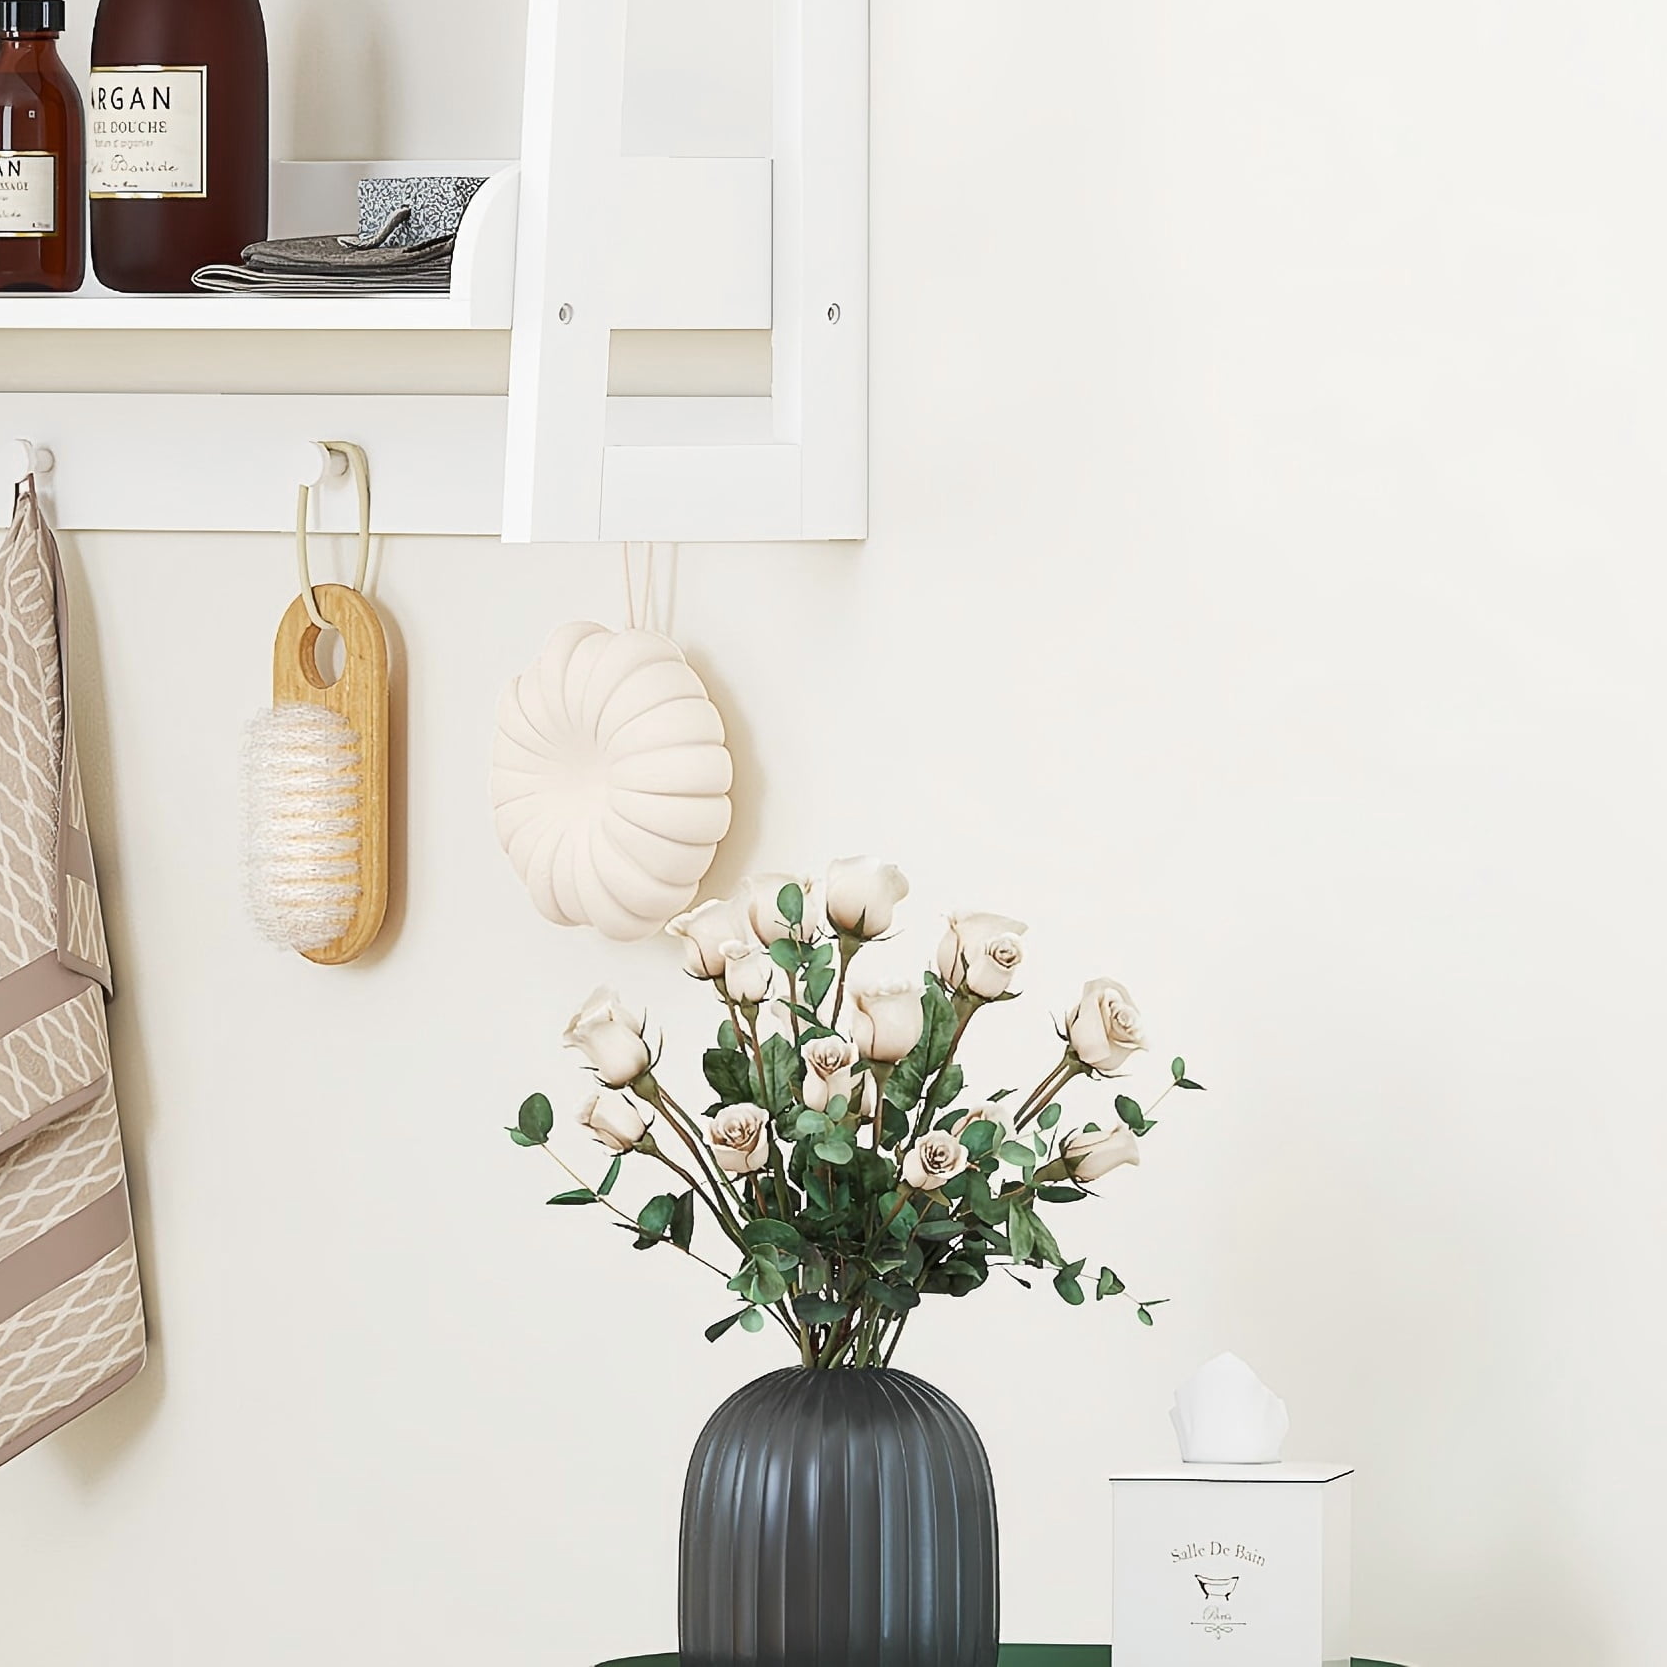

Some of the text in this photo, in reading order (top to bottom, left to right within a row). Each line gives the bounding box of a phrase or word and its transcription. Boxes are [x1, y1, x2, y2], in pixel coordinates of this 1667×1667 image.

[110, 120, 168, 134] DOUCHE
[1170, 1541, 1266, 1567] Salle De Bain
